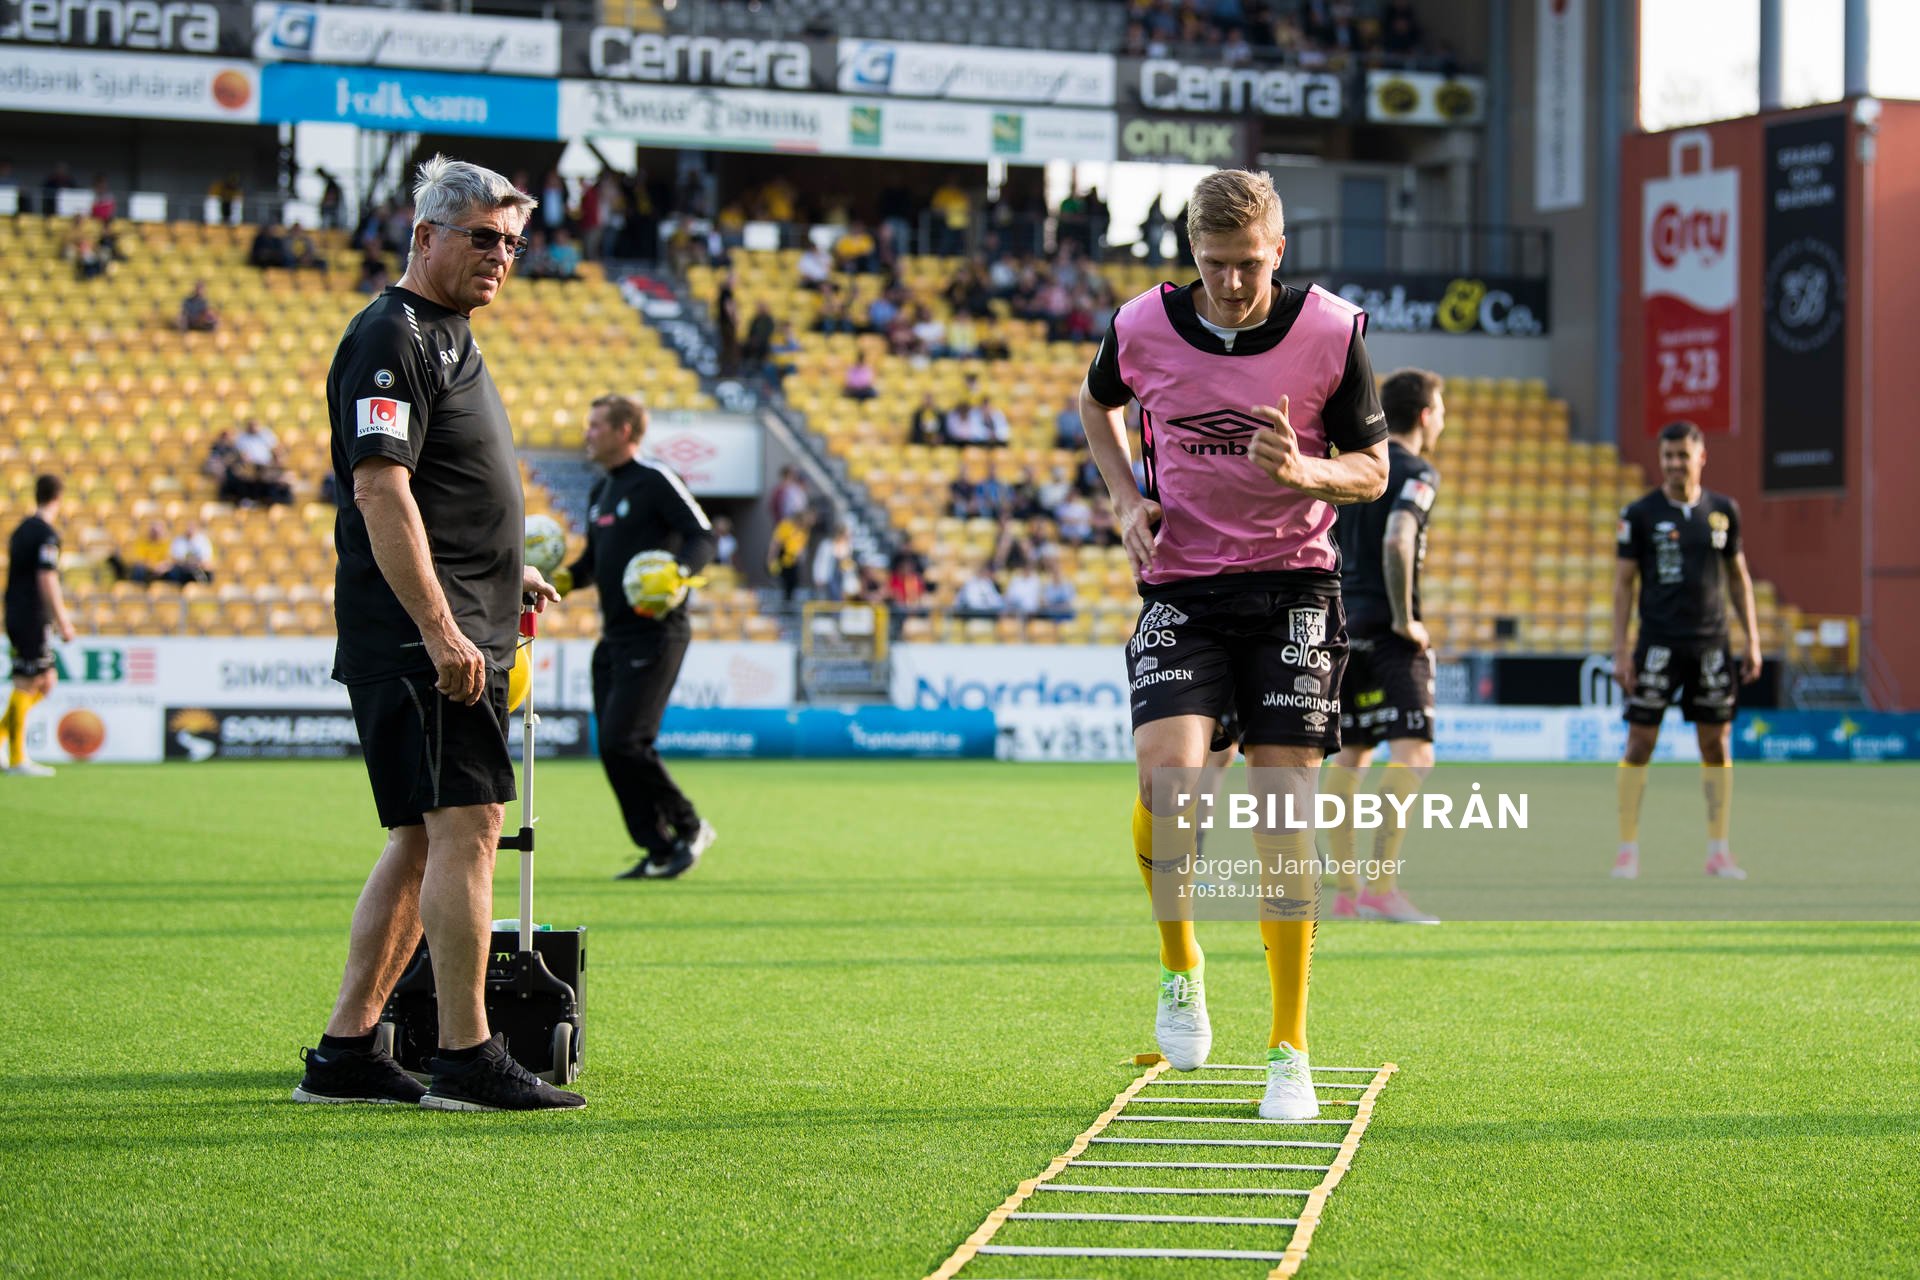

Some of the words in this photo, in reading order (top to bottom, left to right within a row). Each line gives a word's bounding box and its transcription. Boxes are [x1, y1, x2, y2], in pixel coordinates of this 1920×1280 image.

[336, 77, 488, 123] Folksam
[1123, 118, 1233, 164] onyx
[359, 425, 389, 435] SVENSKA
[1181, 440, 1249, 457] umb
[1292, 611, 1320, 624] EFF
[1293, 623, 1322, 637] EKT
[1130, 629, 1177, 657] ellos
[1280, 638, 1331, 672] ellos
[218, 661, 345, 692] SIMONS
[1130, 669, 1191, 694] NGRINDEN
